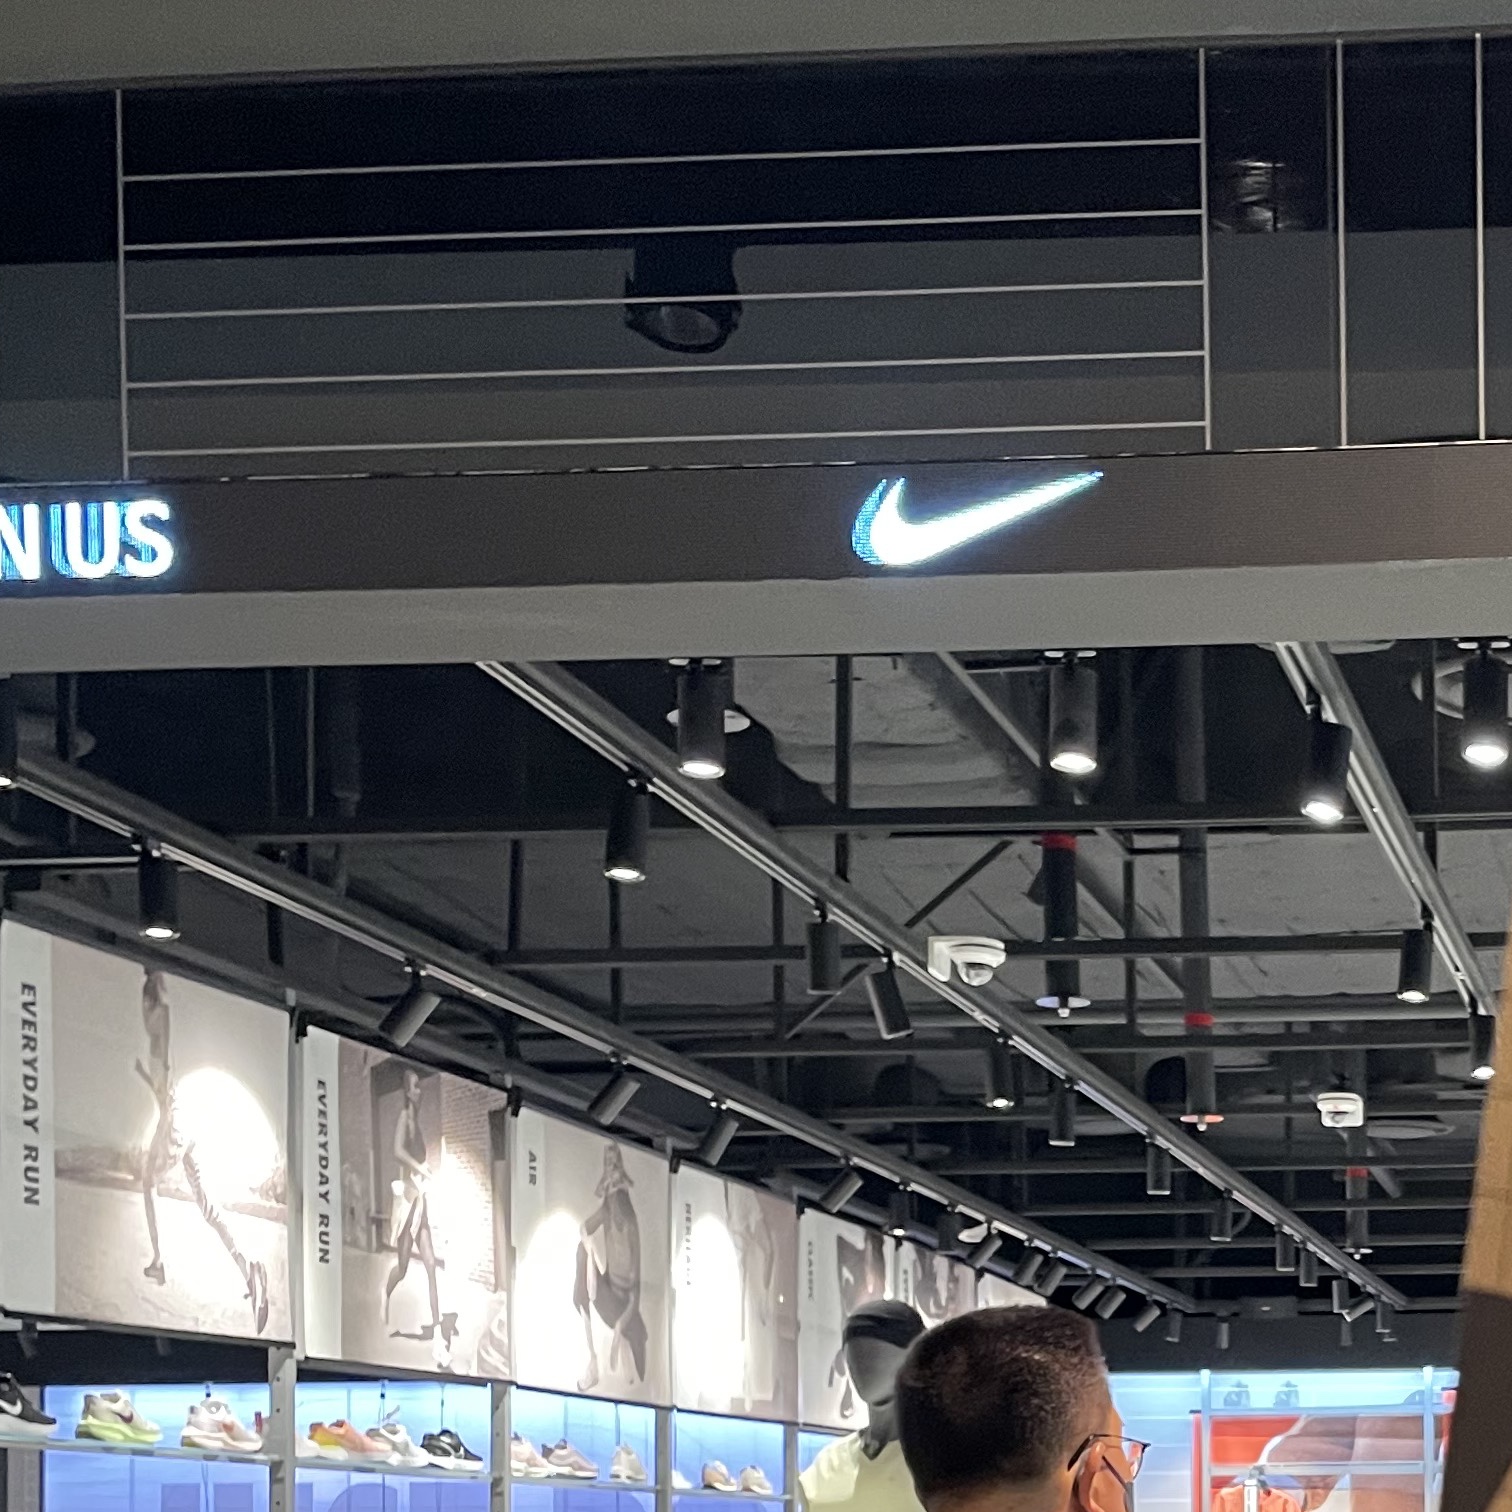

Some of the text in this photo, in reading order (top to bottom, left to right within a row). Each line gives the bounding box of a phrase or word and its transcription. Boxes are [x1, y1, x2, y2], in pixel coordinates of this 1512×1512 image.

[21, 982, 40, 1206] EVERYDAY RUN
[317, 1079, 330, 1265] EVERYDAY RUN
[528, 1149, 537, 1186] AIR
